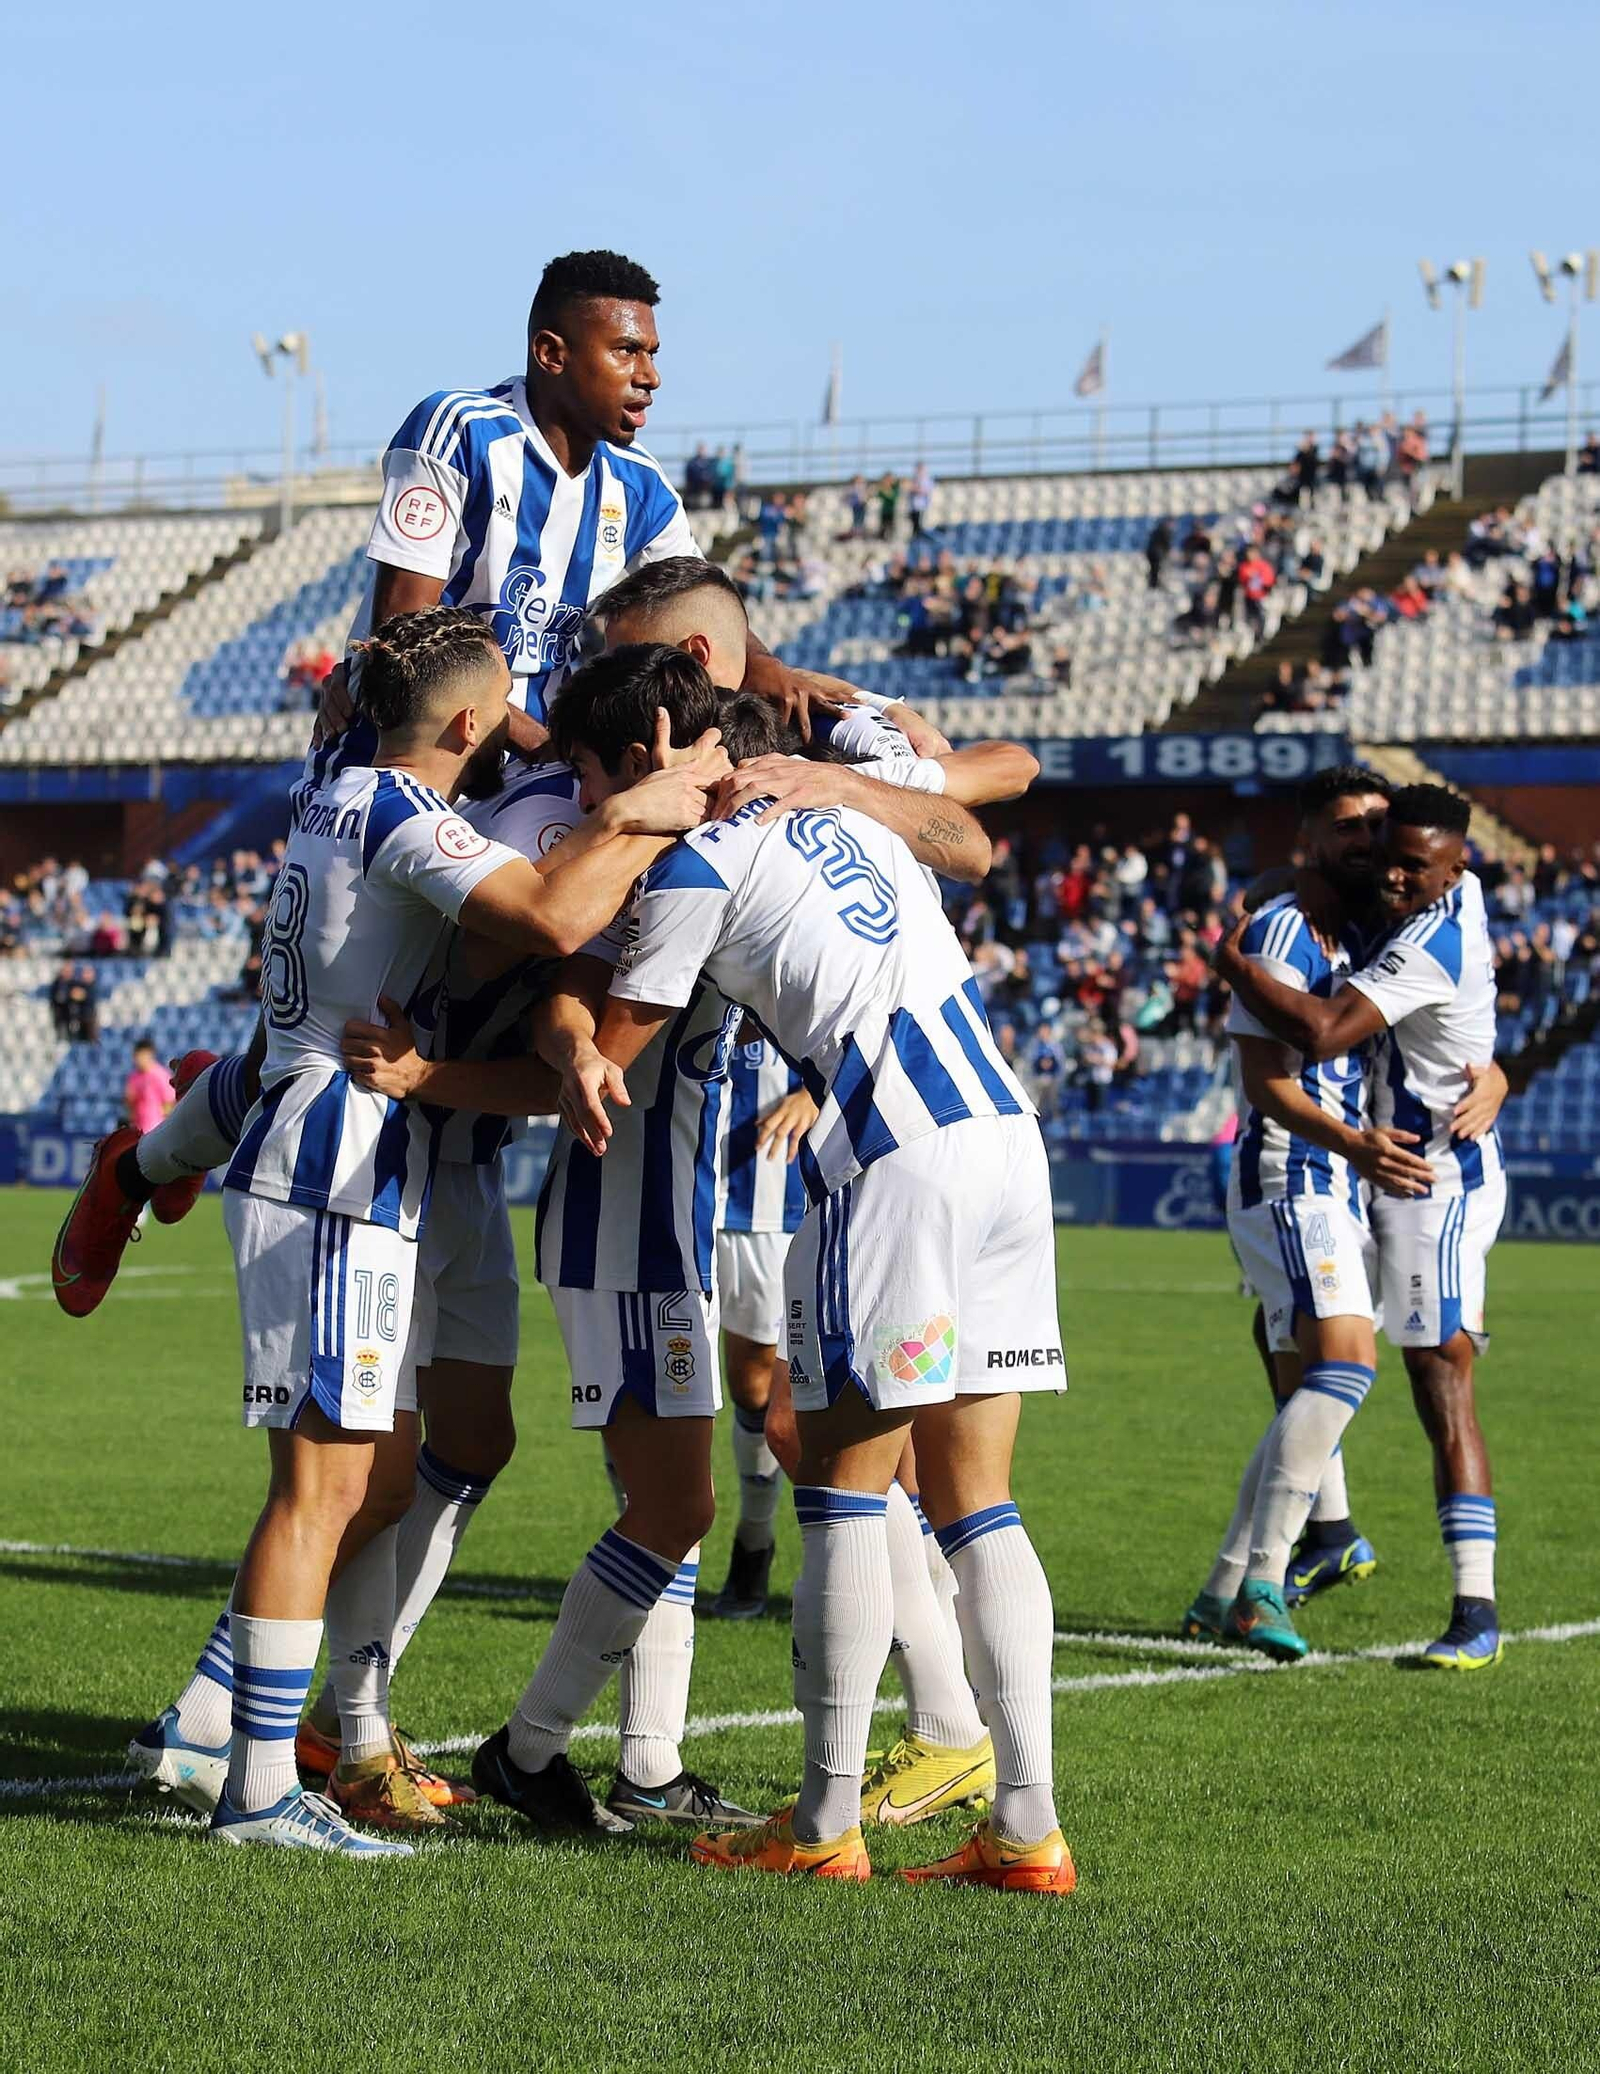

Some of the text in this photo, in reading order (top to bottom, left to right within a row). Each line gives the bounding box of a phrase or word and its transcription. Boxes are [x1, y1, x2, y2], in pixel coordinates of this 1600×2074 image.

[1107, 737, 1309, 779] 1889
[785, 807, 900, 945] 3
[353, 1268, 400, 1343] 18
